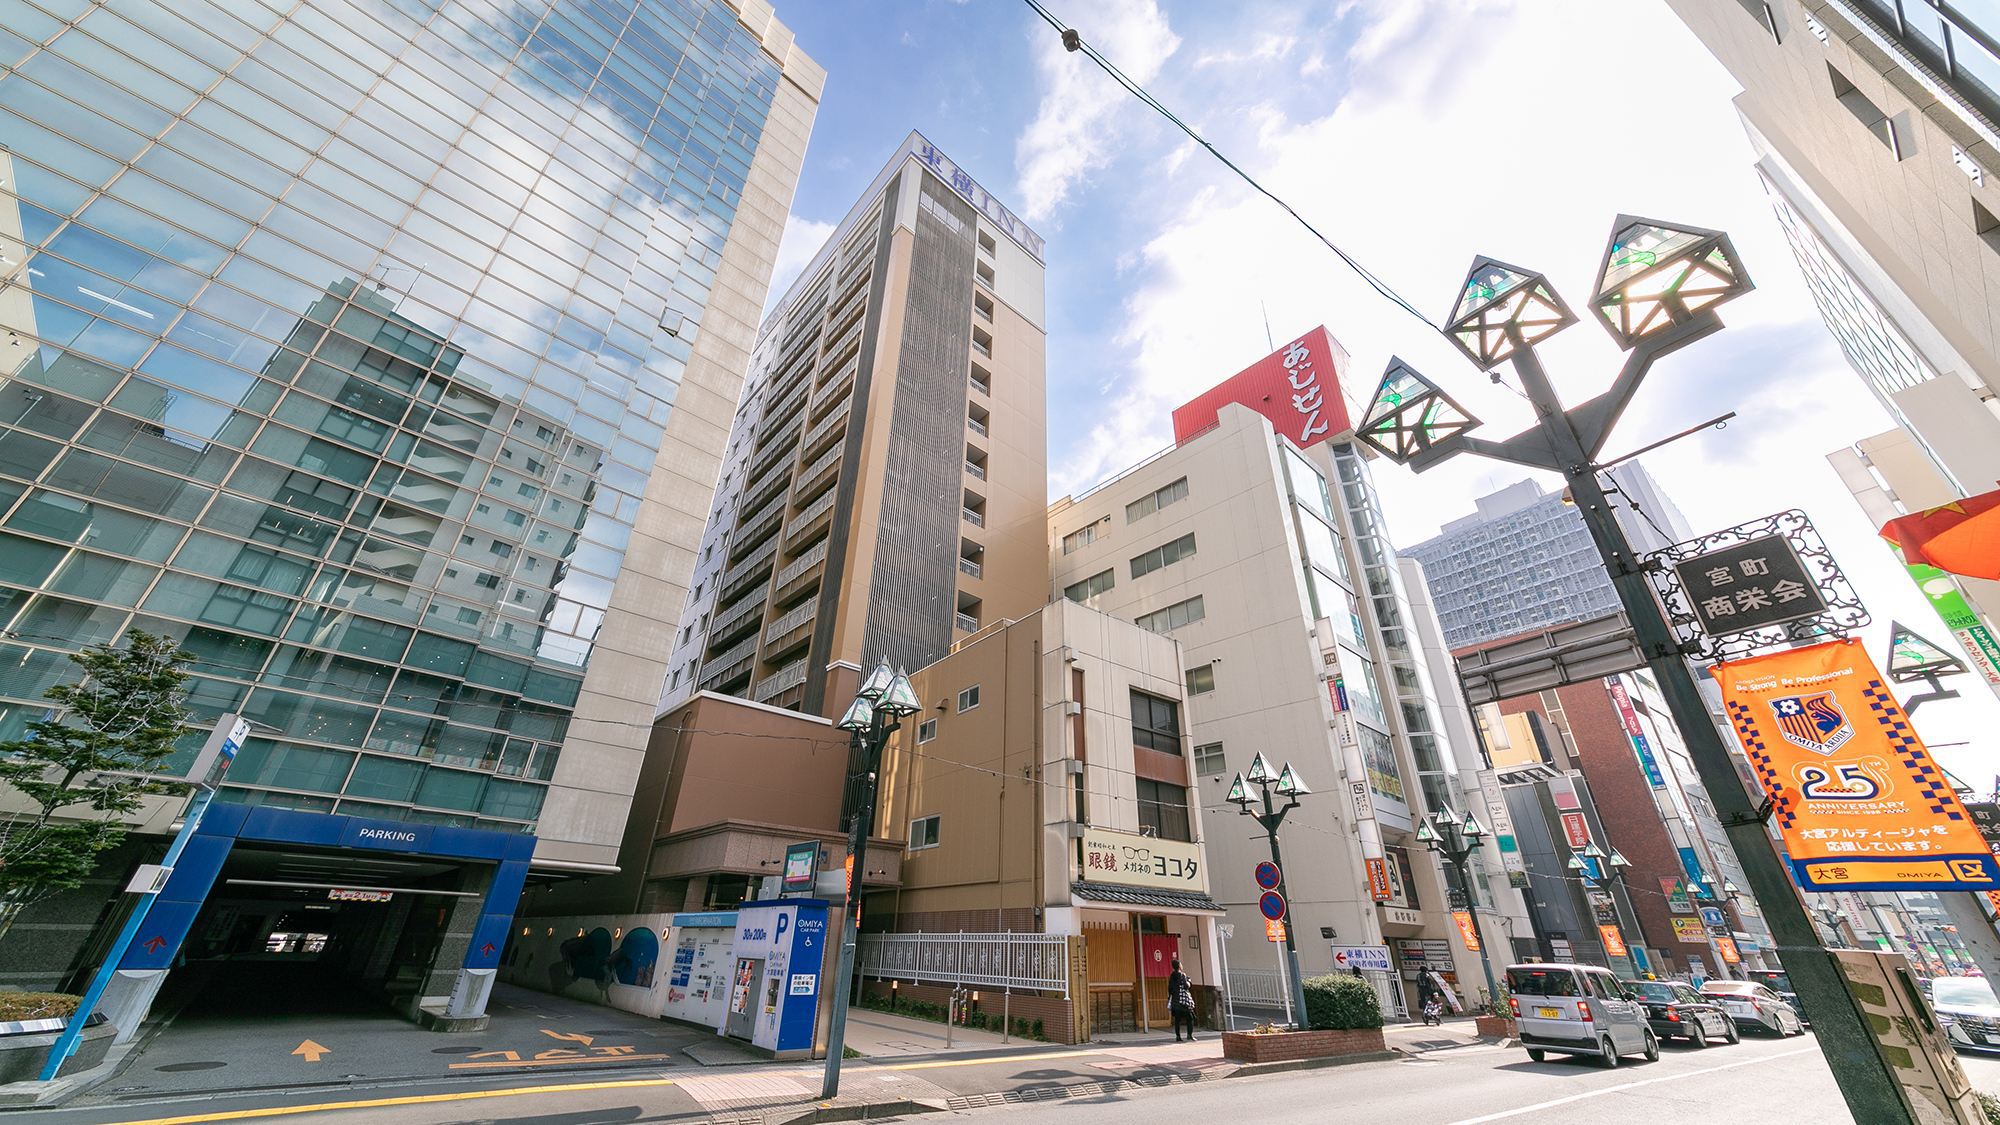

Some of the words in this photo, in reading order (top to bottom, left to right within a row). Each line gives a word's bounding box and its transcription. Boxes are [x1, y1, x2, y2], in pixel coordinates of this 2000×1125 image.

[920, 141, 1045, 255] 東横INN
[1283, 340, 1329, 442] あじせん
[1704, 557, 1770, 587] 宮町
[1701, 579, 1807, 619] 商栄会
[1750, 680, 1778, 691] Strong
[1796, 667, 1854, 684] Professional
[1788, 734, 1823, 751] OMIYA
[1801, 764, 1880, 800] 25
[1807, 801, 1905, 810] ANNIVERSARY
[1975, 811, 1991, 820] 町
[359, 828, 416, 842] PARKING
[1800, 825, 1948, 840] 大宮アルディージャを
[1826, 840, 1943, 852] 応援しています。
[1088, 852, 1118, 872] 眼鏡
[1123, 862, 1151, 874] メガネの
[1153, 856, 1198, 880] ヨコタ
[1813, 867, 1849, 880] 大宮
[775, 913, 789, 945] P
[797, 919, 823, 929] OMIYA
[1346, 949, 1386, 959] 東横INN
